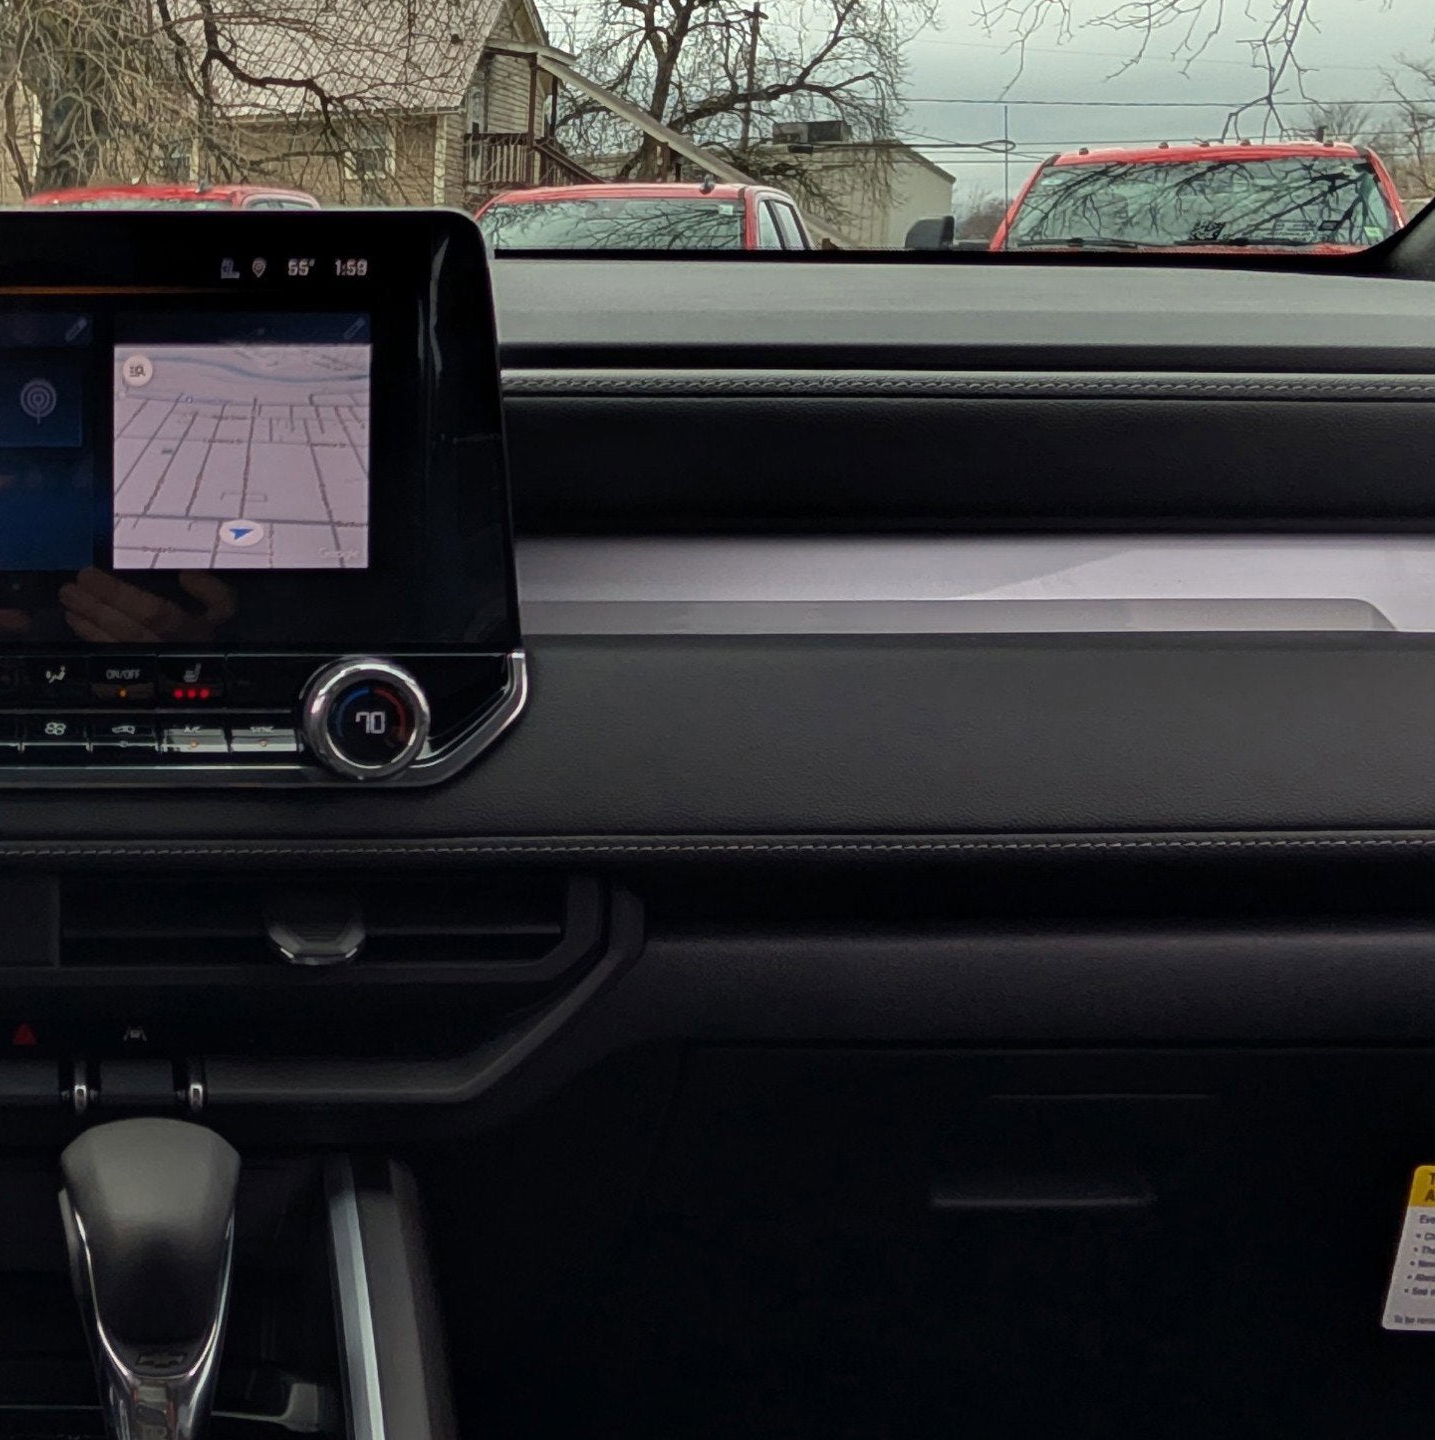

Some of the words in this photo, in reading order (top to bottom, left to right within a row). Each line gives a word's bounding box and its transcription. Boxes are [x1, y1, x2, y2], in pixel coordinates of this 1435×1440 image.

[335, 258, 368, 276] 1:59
[106, 669, 140, 680] ON/OFF
[355, 710, 387, 734] 70
